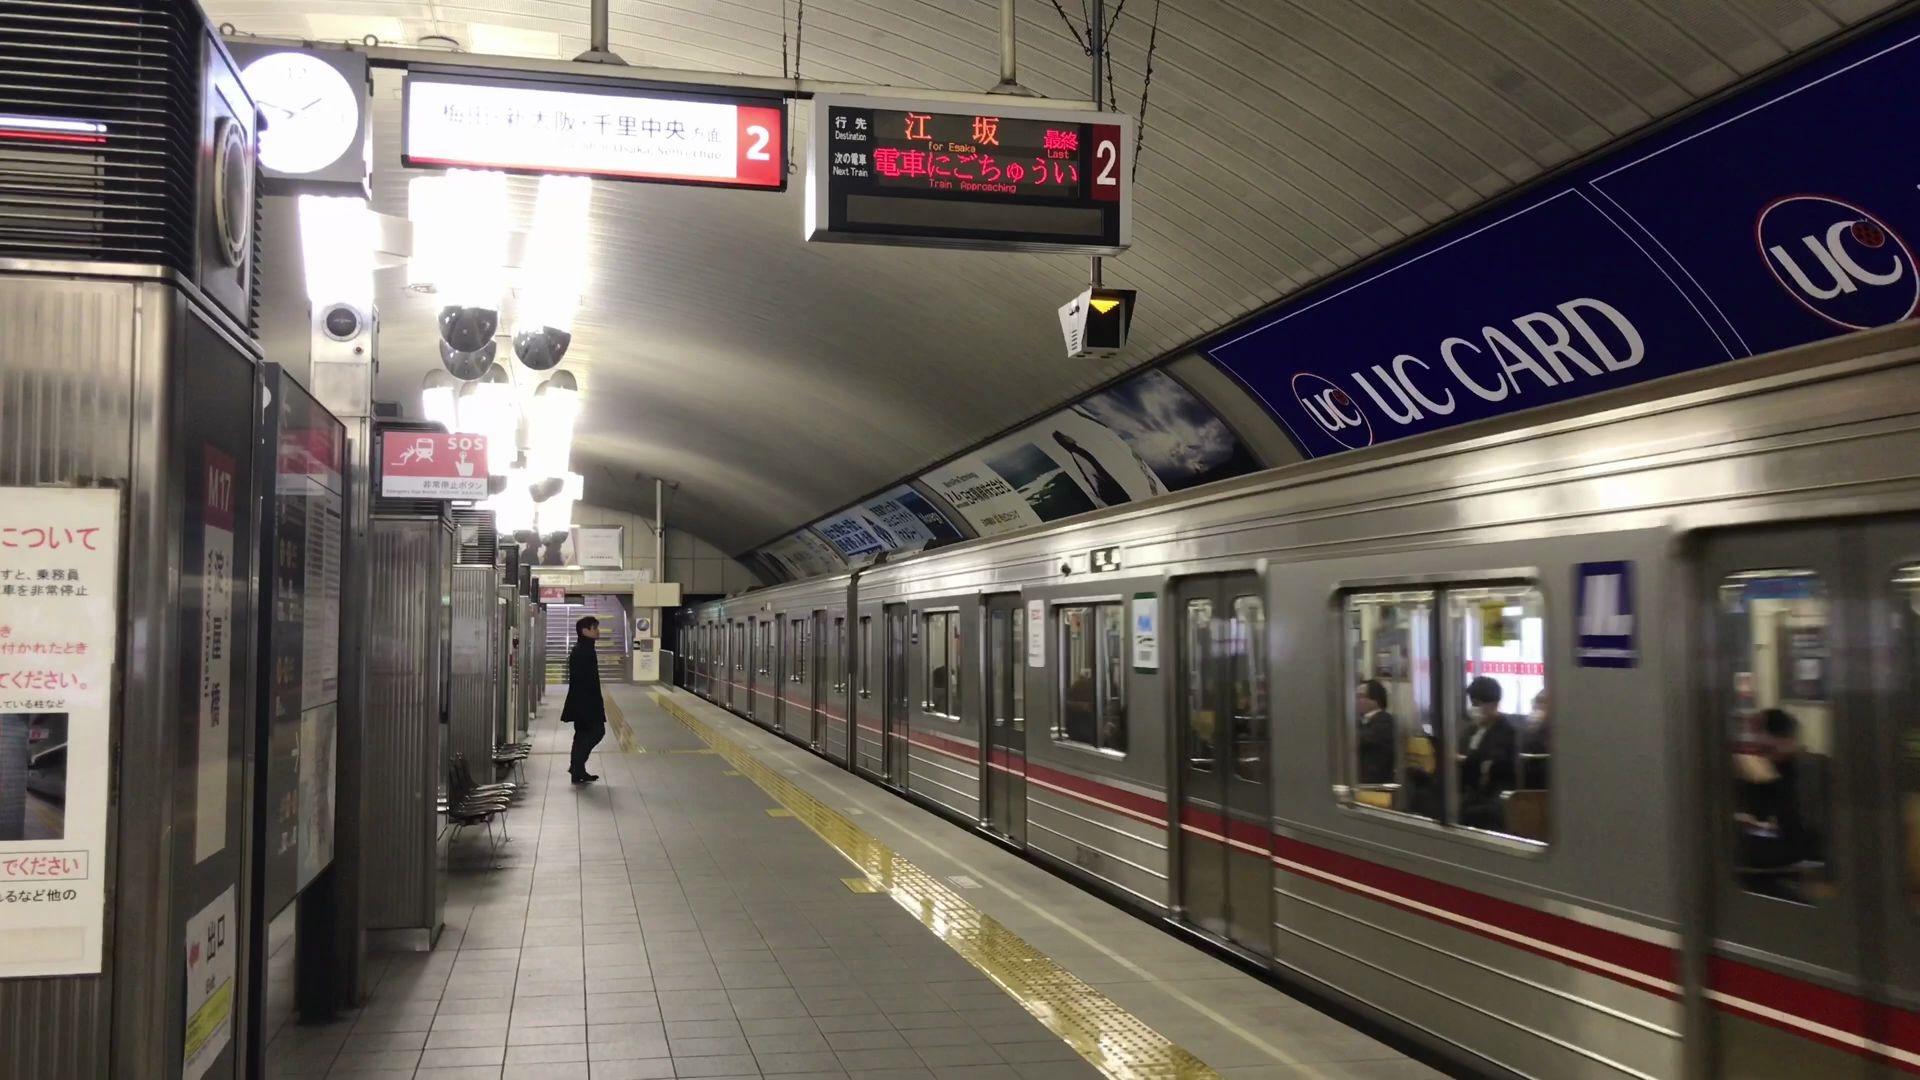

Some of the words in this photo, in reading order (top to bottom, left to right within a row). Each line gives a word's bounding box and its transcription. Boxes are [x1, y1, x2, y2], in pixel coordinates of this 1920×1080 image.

[834, 116, 868, 130] 行先
[904, 111, 1000, 147] 江坂
[746, 125, 771, 161] 2
[834, 130, 867, 142] Destination
[1043, 129, 1079, 151] 最終
[928, 141, 944, 151] for
[948, 142, 976, 153] Esaka
[834, 152, 868, 166] 次の電車
[1047, 150, 1070, 160] Last
[873, 147, 1080, 186] 電車にごちゅうい
[1096, 139, 1117, 186] 2
[832, 166, 850, 177] Next
[850, 167, 869, 178] Train
[929, 179, 953, 189] Train
[960, 181, 1017, 194] Approaching
[1351, 354, 1456, 425] UC
[1440, 297, 1645, 402] CARD
[447, 437, 484, 451] SOS
[207, 464, 232, 513] M17
[423, 480, 483, 489] 非常停止ボタン
[0, 568, 80, 582] すと、乗務員
[0, 585, 88, 597] 車を非常停止
[0, 700, 65, 709] ている柱など
[3, 856, 79, 876] でください
[0, 889, 77, 903] るなど他の
